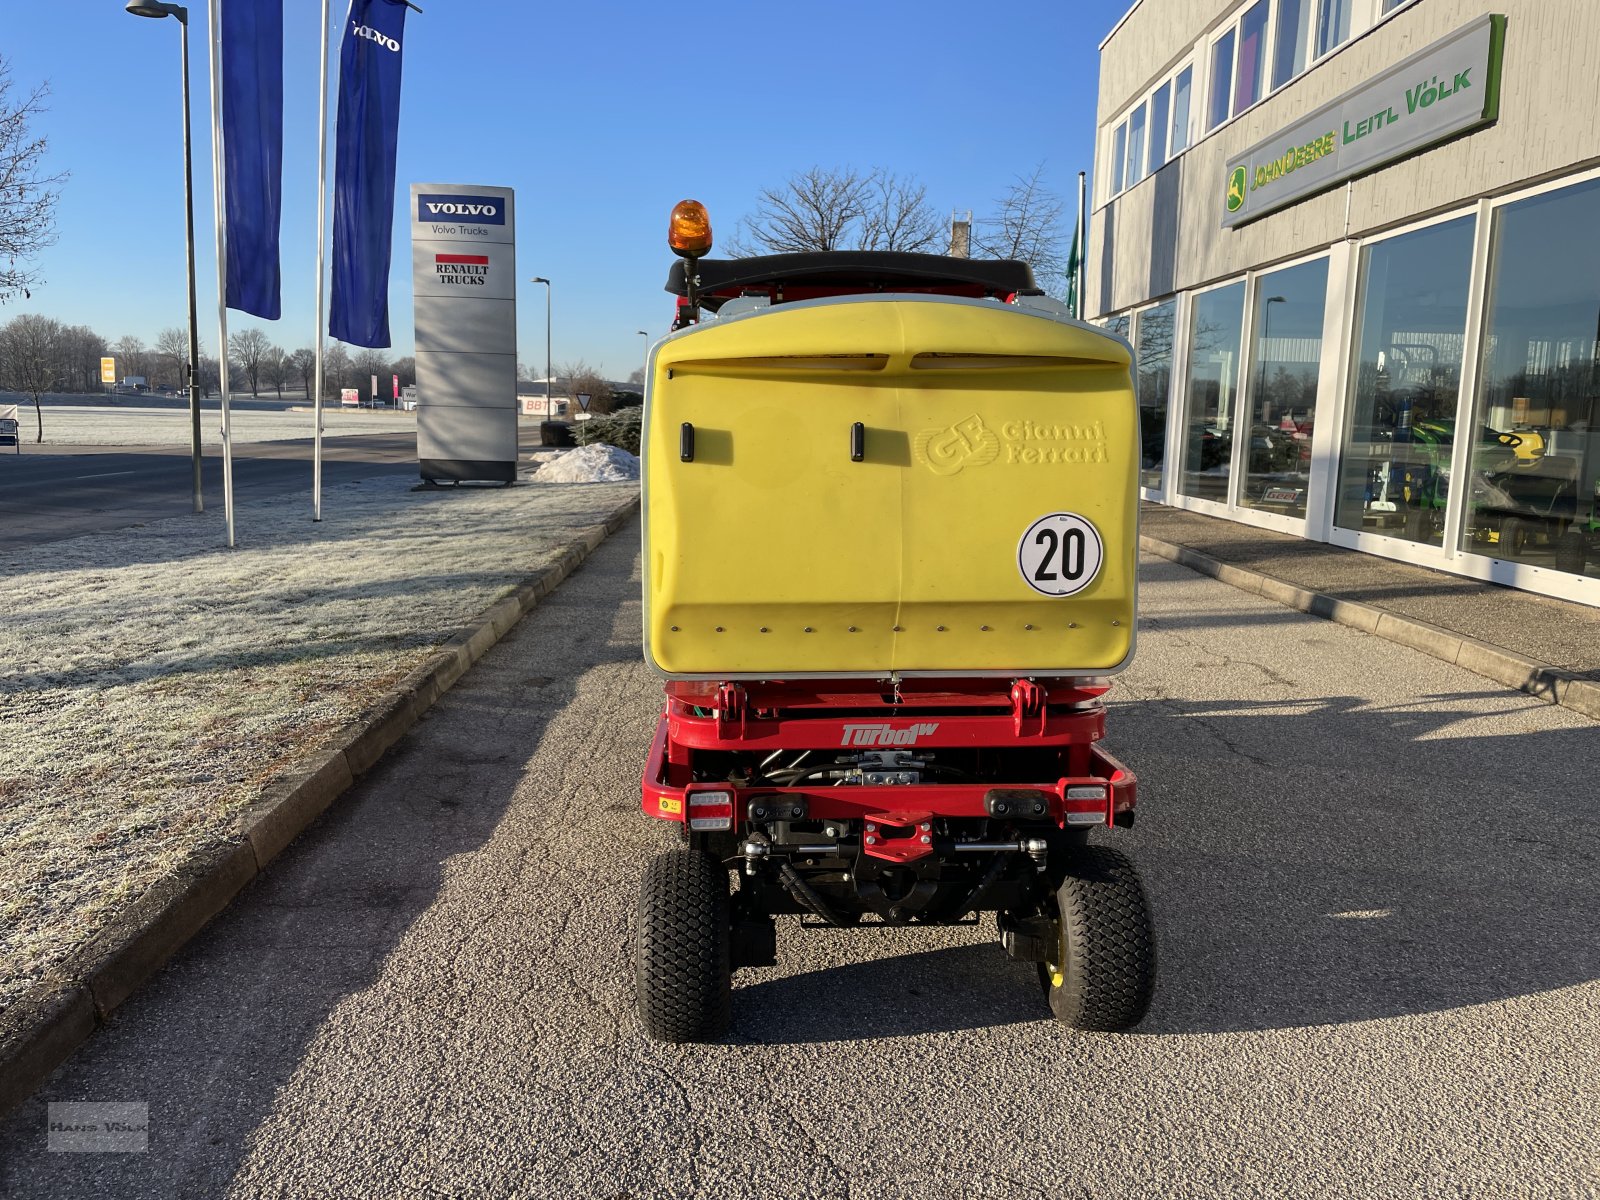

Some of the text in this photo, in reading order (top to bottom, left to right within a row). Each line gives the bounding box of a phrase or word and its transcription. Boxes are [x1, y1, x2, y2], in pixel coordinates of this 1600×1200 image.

[1342, 67, 1472, 146] LEITL VÖLK
[426, 203, 497, 217] VOLVO
[432, 225, 489, 236] Volvo Trucks
[436, 264, 489, 275] RENAULT
[440, 275, 485, 286] TRUCKS
[1002, 419, 1109, 441] Gianni
[1006, 443, 1110, 465] Ferrari
[1034, 527, 1086, 581] 20
